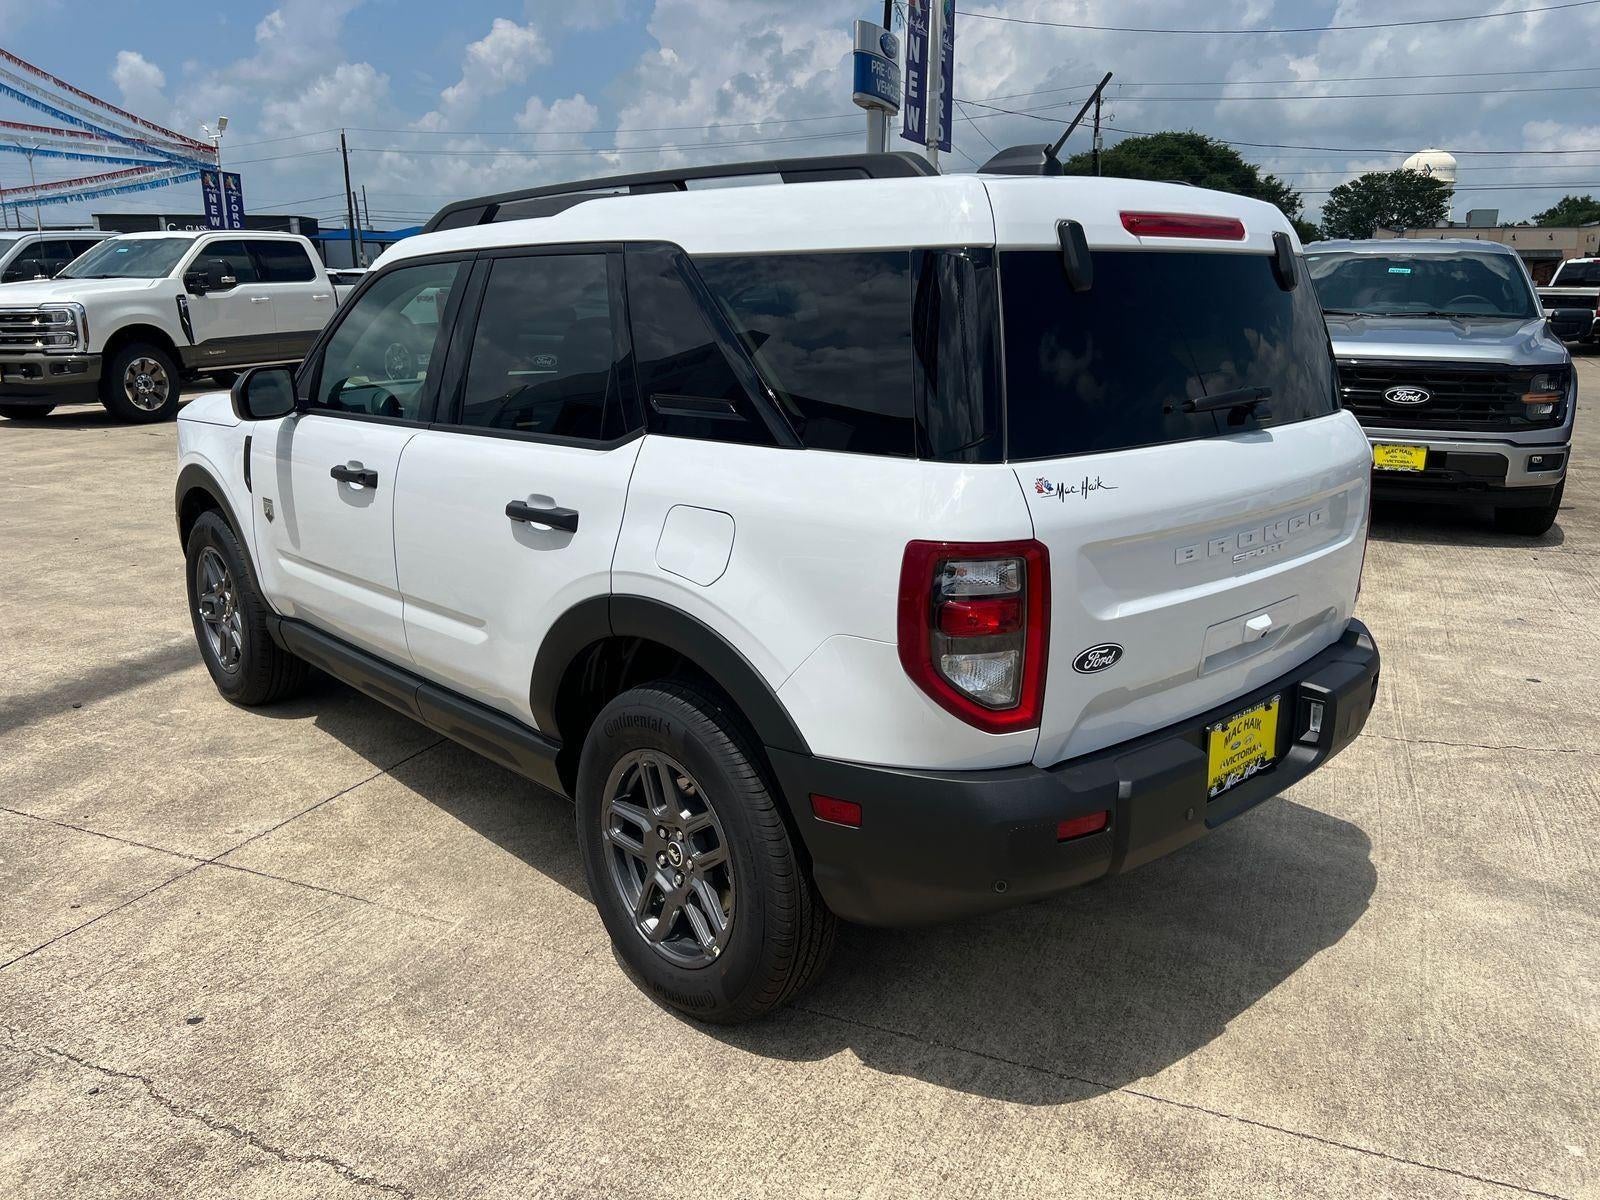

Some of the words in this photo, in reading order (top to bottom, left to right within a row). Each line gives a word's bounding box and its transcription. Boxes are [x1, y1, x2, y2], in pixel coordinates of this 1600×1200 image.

[906, 34, 920, 133] NEW
[208, 193, 220, 227] NEW
[231, 195, 241, 229] FORD
[1393, 390, 1422, 401] Ford
[1040, 482, 1079, 503] Mac
[1081, 475, 1119, 500] Haik
[1174, 508, 1326, 565] BRONCO
[1232, 540, 1288, 564] SPORT
[1084, 648, 1115, 669] Ford
[604, 712, 663, 737] Continental
[1224, 721, 1243, 748] MAC
[1243, 717, 1263, 732] HAIK
